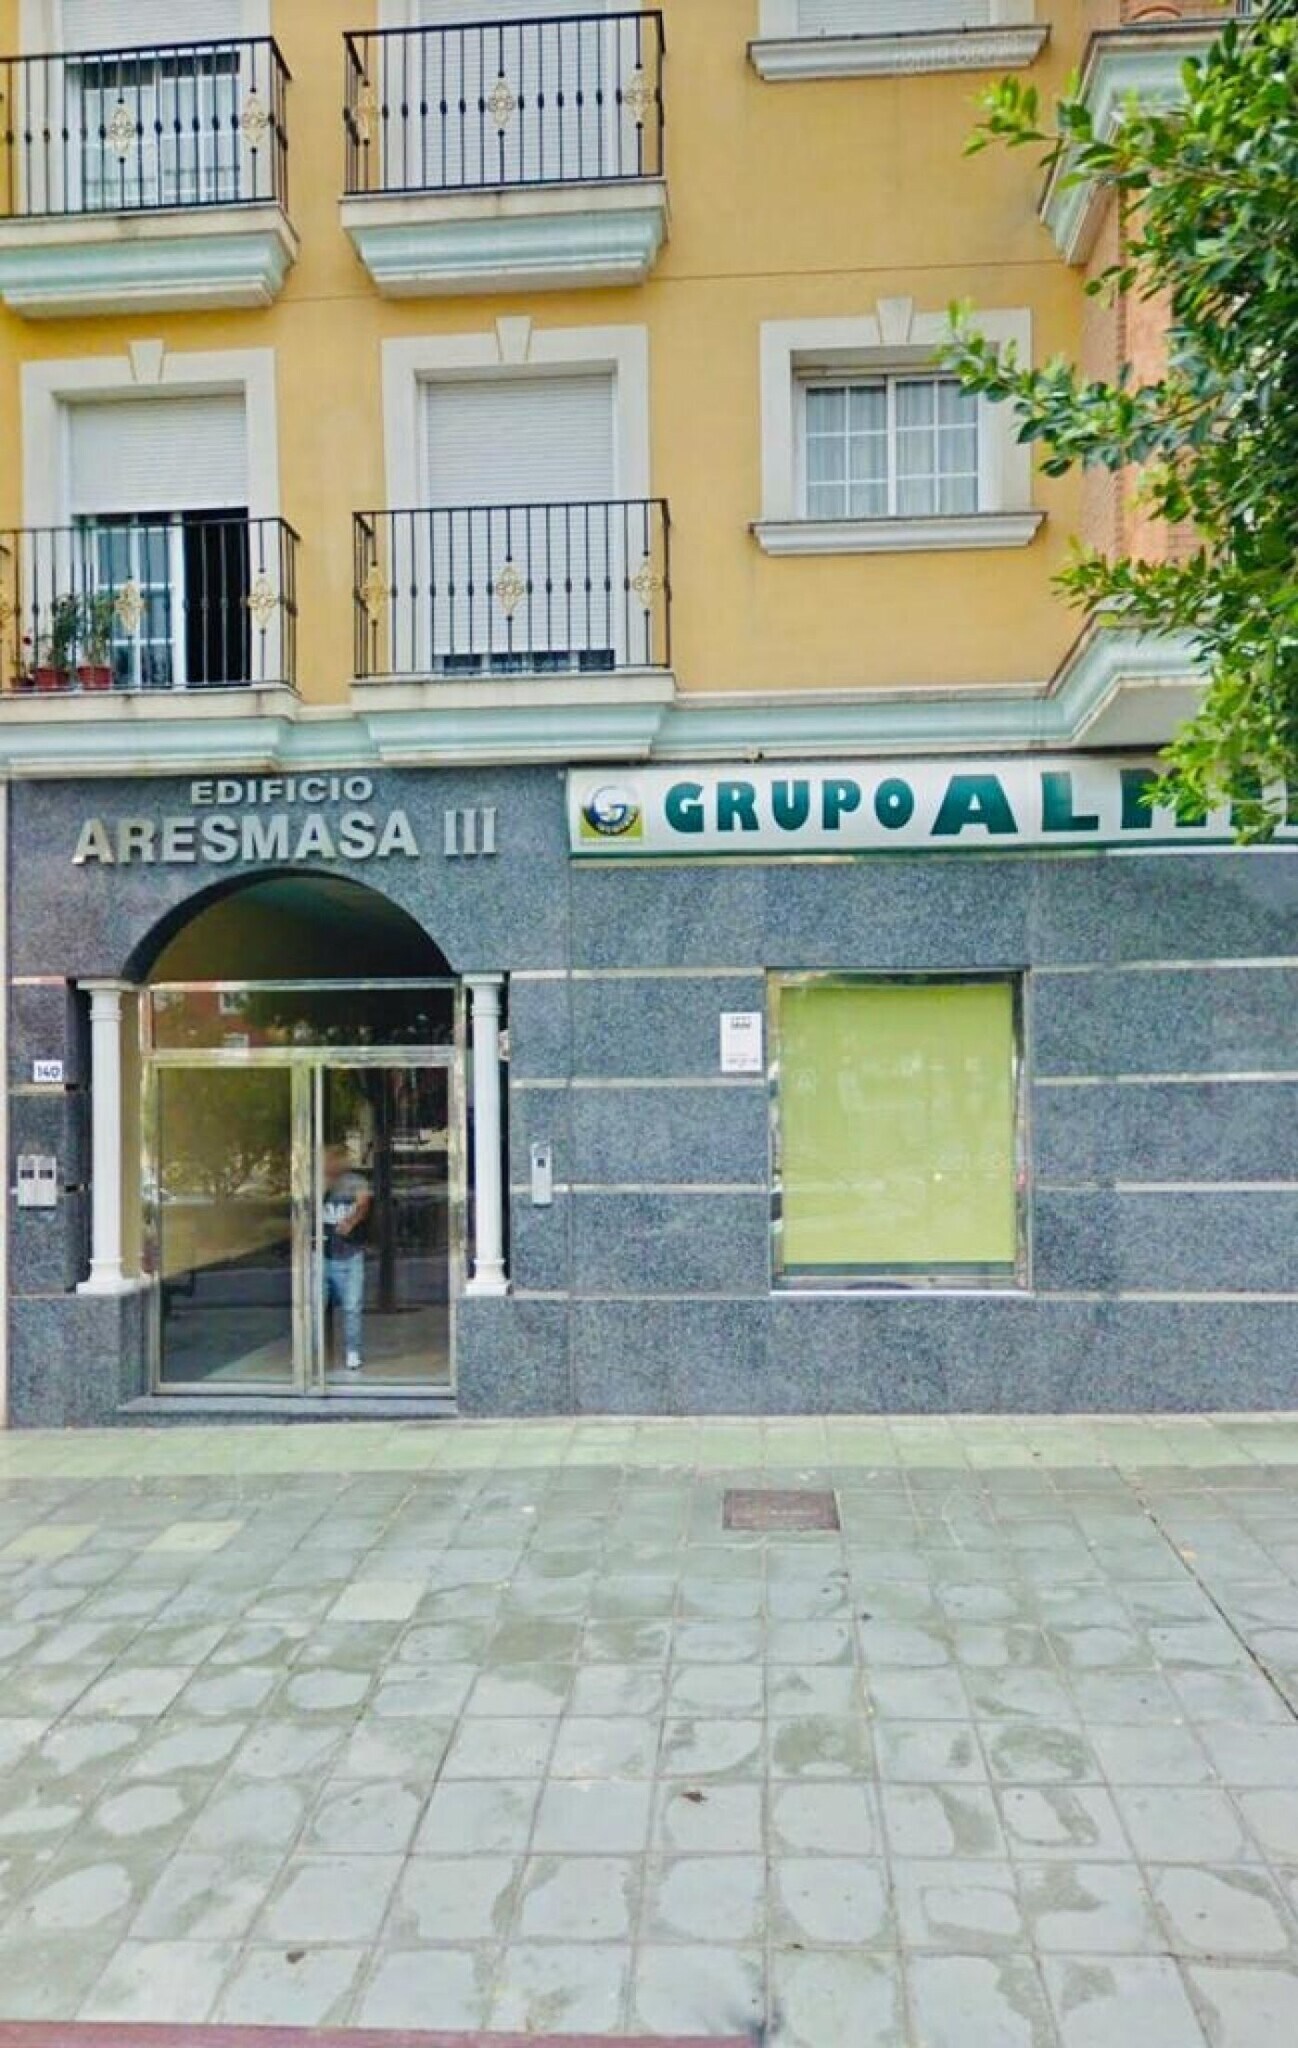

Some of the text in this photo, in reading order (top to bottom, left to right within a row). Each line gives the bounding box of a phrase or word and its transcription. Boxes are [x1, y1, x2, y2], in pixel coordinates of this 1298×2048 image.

[191, 776, 373, 804] EDIFICIO
[664, 778, 914, 833] GRUPO
[71, 808, 497, 864] ARESMASA III
